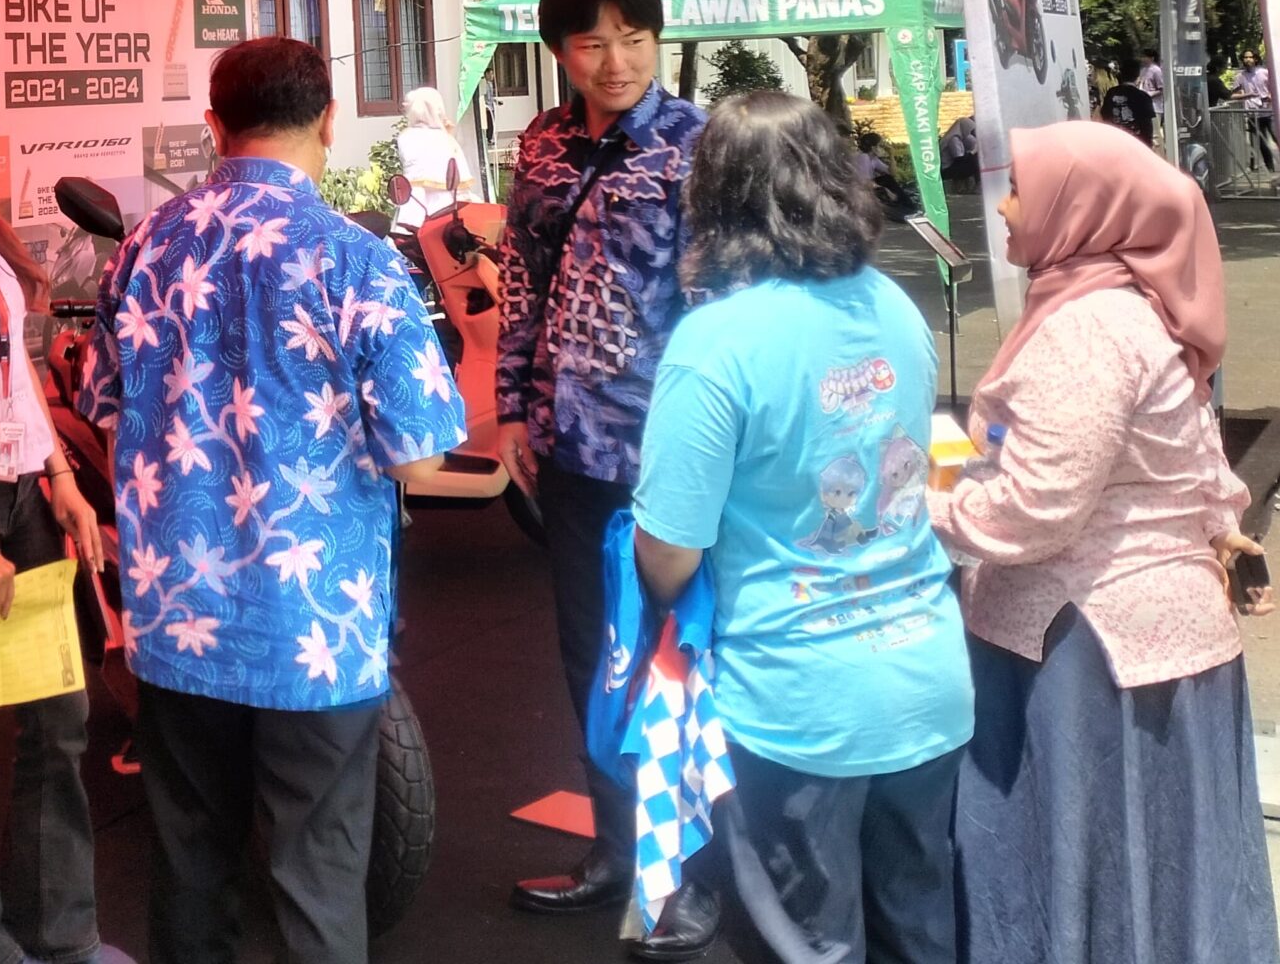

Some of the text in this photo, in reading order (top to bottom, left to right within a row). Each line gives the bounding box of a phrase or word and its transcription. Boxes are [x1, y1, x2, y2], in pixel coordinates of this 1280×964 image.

[201, 4, 238, 15] HONDA
[202, 28, 217, 41] One
[5, 32, 151, 65] THE YEAR
[10, 78, 65, 103] 2021
[86, 76, 140, 100] 2024
[914, 96, 931, 133] KAKI
[170, 149, 183, 158] THE
[920, 137, 936, 174] TIGA
[38, 196, 53, 205] THE
[38, 206, 58, 216] 2022
